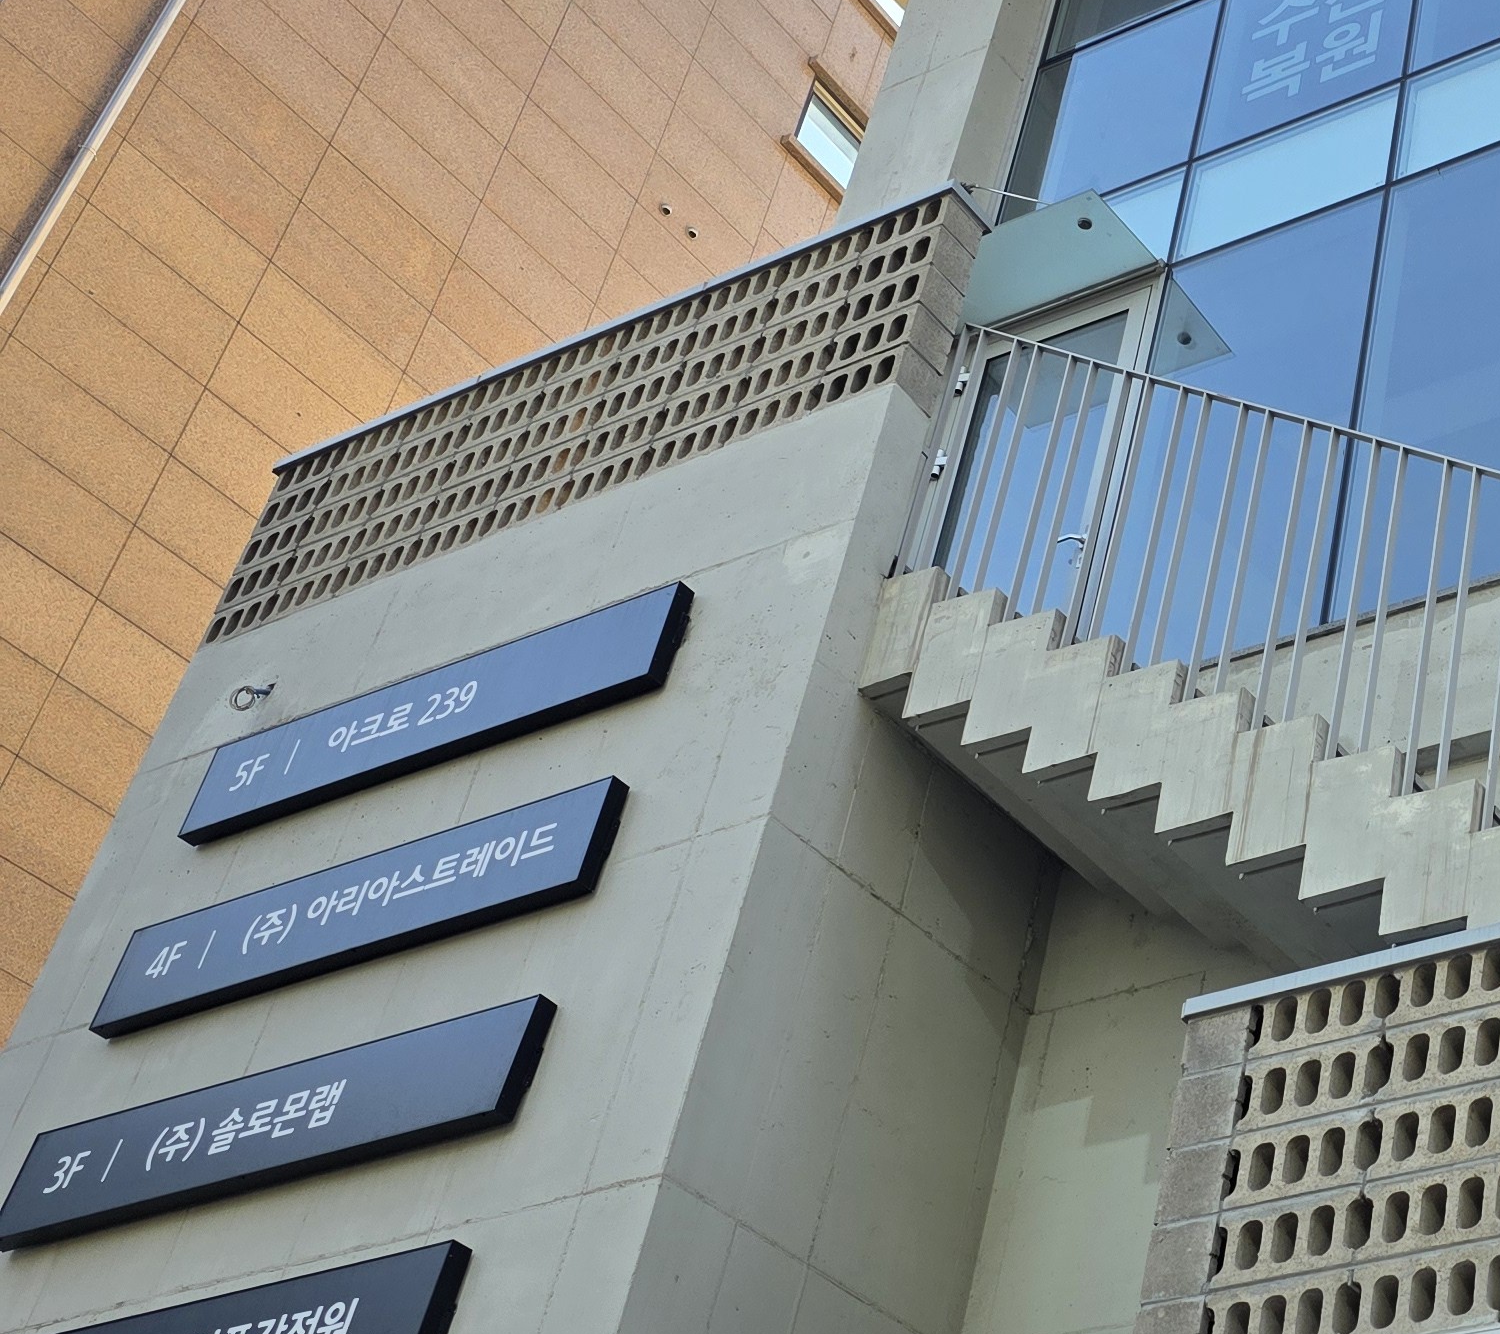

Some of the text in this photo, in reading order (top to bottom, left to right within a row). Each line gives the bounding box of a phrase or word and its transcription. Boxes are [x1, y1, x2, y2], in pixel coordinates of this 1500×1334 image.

[1241, 7, 1384, 103] 복원
[229, 680, 478, 792] 5F 아크로 239
[145, 823, 557, 980] 4F (주) 아리아스트레이드
[43, 1079, 347, 1195] 3F (주) 솔로몬랩
